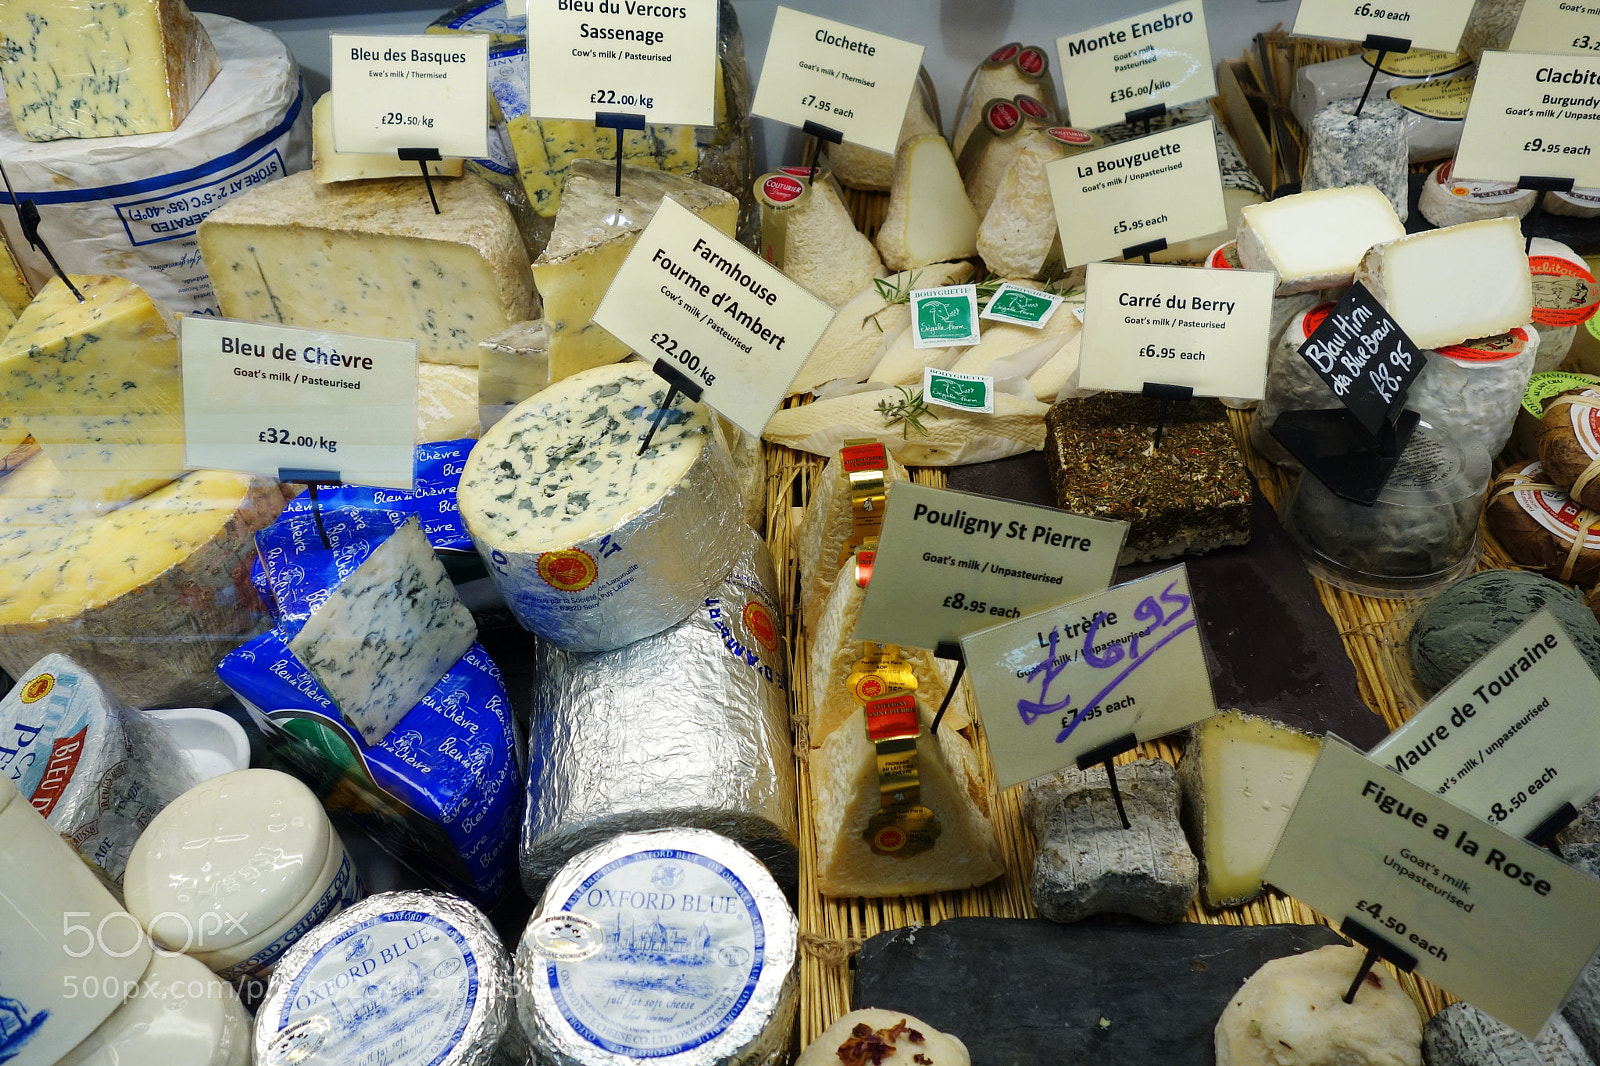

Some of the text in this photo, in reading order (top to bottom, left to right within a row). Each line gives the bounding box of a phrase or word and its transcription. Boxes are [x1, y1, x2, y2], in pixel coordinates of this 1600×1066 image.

[558, 0, 686, 18] Bleu du Vercors
[1354, 2, 1410, 22] £6.90 each
[1560, 2, 1586, 14] Goat's
[580, 24, 664, 45] Sassenage
[816, 30, 876, 56] Clochette
[1068, 11, 1193, 56] Monte Enebro
[1572, 35, 1600, 50] £3.2
[351, 48, 466, 65] Bleu des Basques
[572, 49, 672, 62] Cow's milk Pasteurised
[1114, 44, 1155, 62] Goat's milk
[1115, 56, 1157, 72] Pasteurised
[369, 70, 388, 78] Ewe's
[798, 61, 875, 88] Goat's milk Thermised
[802, 95, 854, 118] £7.95 each
[1542, 94, 1600, 108] Burgundy
[1506, 107, 1600, 121] Goat's milk Unpaste
[1524, 138, 1590, 156] £9.95 each
[244, 161, 278, 184] STORE
[1078, 143, 1181, 178] La Bouyguette
[230, 179, 242, 194] AT
[1082, 162, 1182, 193] Goat's milk Unpasteurised
[1114, 214, 1168, 234] £5.95 each
[692, 238, 777, 306] Farmhouse
[652, 249, 786, 351] Fourme d'Ambert
[1119, 292, 1235, 315] Carré du Berry
[660, 286, 752, 354] Cow's milk Pasteurised
[1124, 316, 1226, 329] Goat's milk Pasteurised
[222, 337, 373, 370] Bleu de Chèvre
[1139, 344, 1206, 360] £6.95 each
[1305, 332, 1346, 374] Blau
[1340, 346, 1371, 378] Blue
[1360, 318, 1395, 354] Brain
[234, 367, 360, 390] Goat's milk Pasteurised
[420, 450, 460, 462] Chèvre
[374, 492, 402, 504] Bleu
[416, 486, 458, 498] Chèvre
[913, 503, 1002, 539] Pouligny
[1006, 521, 1026, 540] St
[1032, 525, 1092, 552] Pierre
[922, 552, 1063, 585] Goat's milk Unpasteurised
[942, 592, 1021, 618] £8.95 each
[270, 660, 292, 680] Bleu
[298, 680, 331, 708] Chèvre
[1450, 703, 1477, 728] de
[1473, 634, 1558, 704] Touraine
[1106, 696, 1136, 714] each
[444, 704, 479, 734] Chèvre
[438, 737, 462, 762] Bleu
[1457, 756, 1480, 779] milk
[1485, 697, 1550, 756] unpasteurised
[41, 740, 80, 790] BLEU
[395, 746, 431, 774] Chèvre
[1527, 766, 1558, 795] each
[1362, 780, 1552, 896] Figue a la Rose
[1400, 848, 1472, 894] Goat's milk
[1384, 855, 1475, 914] Unpasteurised
[588, 889, 738, 914] OXFORD BLUE
[284, 893, 332, 942] CHEESE
[1356, 900, 1448, 962] £4.50 each
[296, 926, 432, 1012] OXFORD BLUE
[666, 999, 695, 1010] cheese
